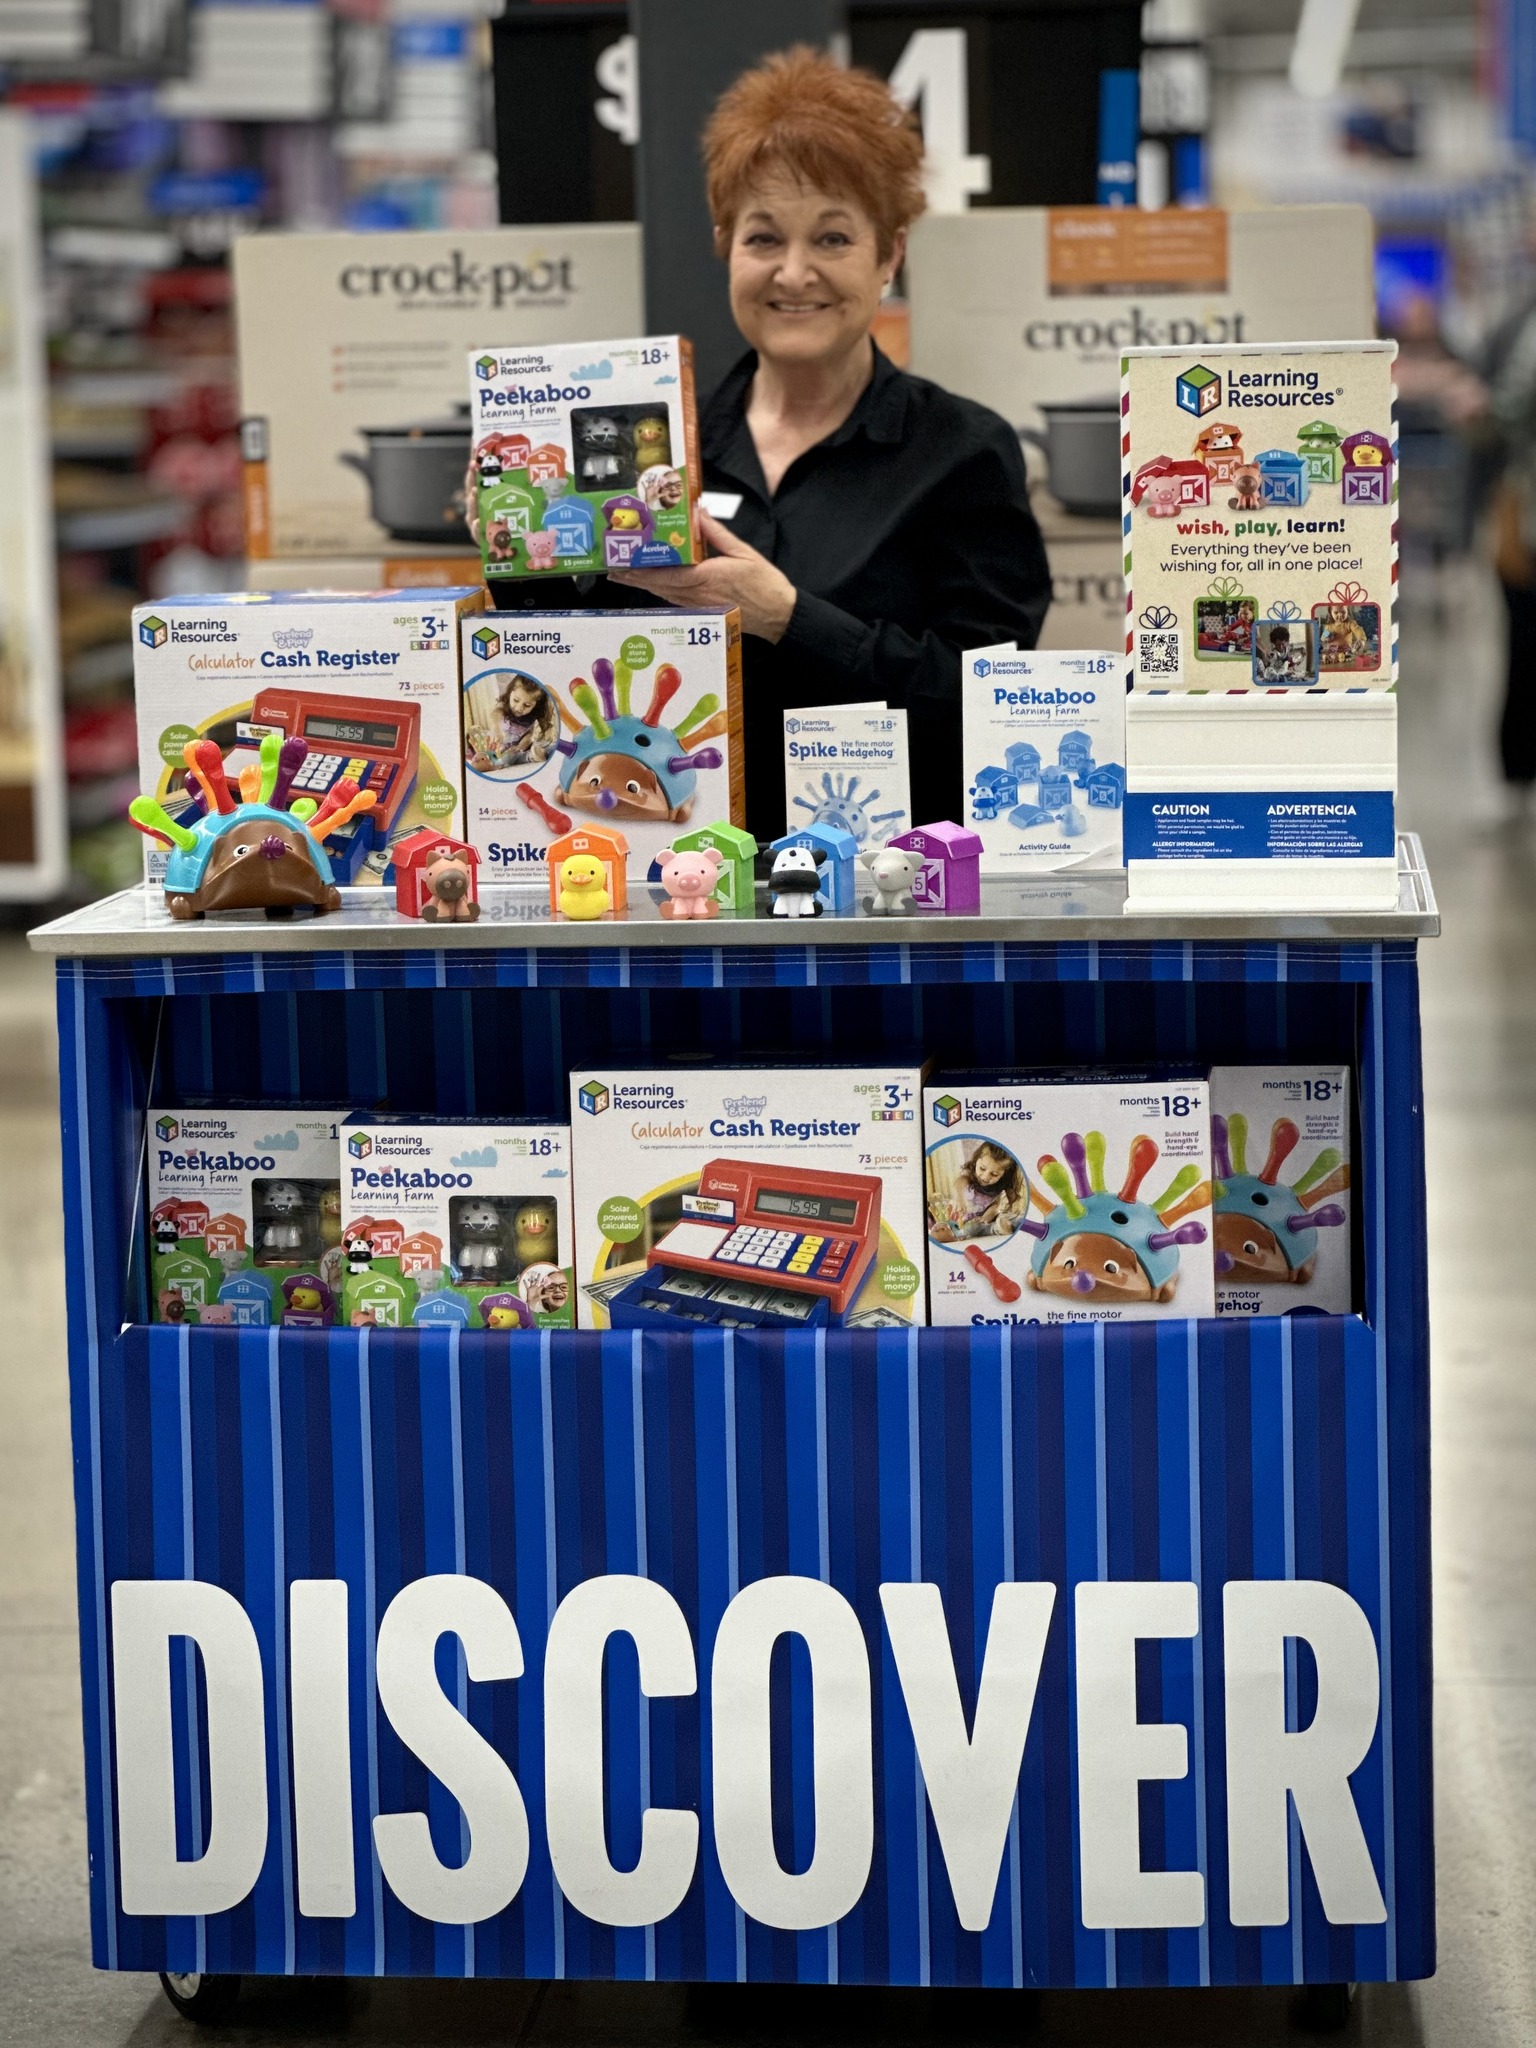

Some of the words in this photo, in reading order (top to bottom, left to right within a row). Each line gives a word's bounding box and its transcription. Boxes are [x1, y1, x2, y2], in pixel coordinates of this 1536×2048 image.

[500, 355, 544, 368] Learning
[641, 348, 670, 365] 18+
[1227, 369, 1319, 390] Learning
[479, 384, 591, 407] Peekaboo
[480, 406, 525, 421] Learning
[529, 404, 557, 417] Farm
[1176, 519, 1230, 536] wish,
[1234, 519, 1282, 538] play,
[1286, 518, 1346, 534] learn!
[1170, 543, 1250, 558] Everything
[1252, 541, 1309, 556] they've
[1313, 541, 1352, 554] been
[563, 558, 572, 567] 15
[573, 558, 594, 568] pieces
[1160, 560, 1217, 574] wishing
[1221, 559, 1244, 573] for,
[1247, 559, 1264, 572] all
[1268, 559, 1281, 571] in
[1285, 561, 1314, 572] one
[1317, 558, 1363, 573] place!
[171, 618, 228, 634] Learning
[393, 615, 418, 626] ages
[421, 616, 449, 639] 3+
[272, 628, 313, 641] Pretend
[503, 630, 561, 646] Learning
[650, 627, 685, 635] months
[687, 627, 722, 646] 18+
[411, 641, 449, 650] STEM
[627, 642, 647, 650] Quills
[628, 649, 647, 657] store
[188, 652, 256, 672] Calculator
[260, 650, 311, 668] Cash
[316, 649, 401, 671] Register
[626, 656, 649, 665] inside!
[992, 660, 1026, 669] Learning
[1086, 659, 1115, 674] 18+
[398, 682, 411, 691] 73
[413, 681, 445, 692] pieces
[993, 686, 1096, 705] Peekaboo
[1010, 705, 1051, 719] Learning
[1055, 704, 1080, 716] Farm
[801, 719, 830, 727] Learning
[880, 720, 898, 730] 18+
[169, 732, 189, 740] Solar
[788, 741, 838, 761] Spike
[841, 740, 854, 748] the
[855, 740, 869, 748] fine
[870, 740, 894, 748] motor
[841, 748, 894, 759] Hedgehog
[425, 785, 448, 793] Holds
[423, 794, 453, 802] life-size
[424, 802, 453, 811] money!
[478, 807, 490, 816] 14
[491, 807, 518, 818] pieces
[1152, 804, 1210, 816] CAUTION
[1266, 804, 1357, 816] ADVERTENCIA
[1019, 843, 1048, 852] Activity
[1049, 842, 1071, 851] Guide
[914, 876, 924, 892] 5
[613, 1083, 674, 1099] Learning
[853, 1083, 881, 1096] ages
[884, 1084, 914, 1109] 3+
[1262, 1079, 1301, 1090] months
[1302, 1079, 1343, 1102] 18+
[722, 1095, 767, 1108] Pretend
[965, 1096, 1023, 1112] Learning
[1119, 1096, 1160, 1106] months
[1161, 1095, 1202, 1118] 18+
[873, 1110, 914, 1121] STEM
[1305, 1114, 1322, 1122] Build
[1322, 1114, 1340, 1122] hand
[181, 1118, 227, 1131] Learning
[296, 1122, 327, 1130] months
[630, 1119, 704, 1141] Calculator
[709, 1119, 765, 1138] Cash
[770, 1118, 861, 1141] Register
[1305, 1121, 1333, 1129] strength
[1182, 1130, 1199, 1138] hand
[1306, 1128, 1338, 1136] hand-eye
[375, 1134, 423, 1147] Learning
[1164, 1137, 1193, 1145] strength
[494, 1138, 527, 1146] months
[529, 1138, 562, 1156] 18+
[1166, 1144, 1198, 1152] hand-eye
[858, 1154, 872, 1164] 73
[874, 1153, 909, 1166] pieces
[1161, 1150, 1204, 1158] coordination!
[158, 1150, 276, 1171] Peekaboo
[158, 1170, 205, 1187] Learning
[209, 1170, 238, 1184] Farm
[350, 1167, 473, 1189] Peekaboo
[350, 1187, 400, 1205] Learning
[405, 1188, 434, 1202] Farm
[609, 1204, 630, 1213] Solar
[603, 1213, 638, 1222] powered
[601, 1222, 640, 1230] calculator
[886, 1265, 911, 1274] Holds
[883, 1273, 917, 1283] life-size
[948, 1271, 966, 1283] 14
[884, 1281, 916, 1292] money!
[1228, 1290, 1261, 1299] motor
[1217, 1299, 1261, 1313] gehog
[1047, 1311, 1065, 1320] the
[1066, 1310, 1088, 1320] fine
[1089, 1309, 1123, 1320] motor
[111, 1573, 1388, 1932] DISCOVER
